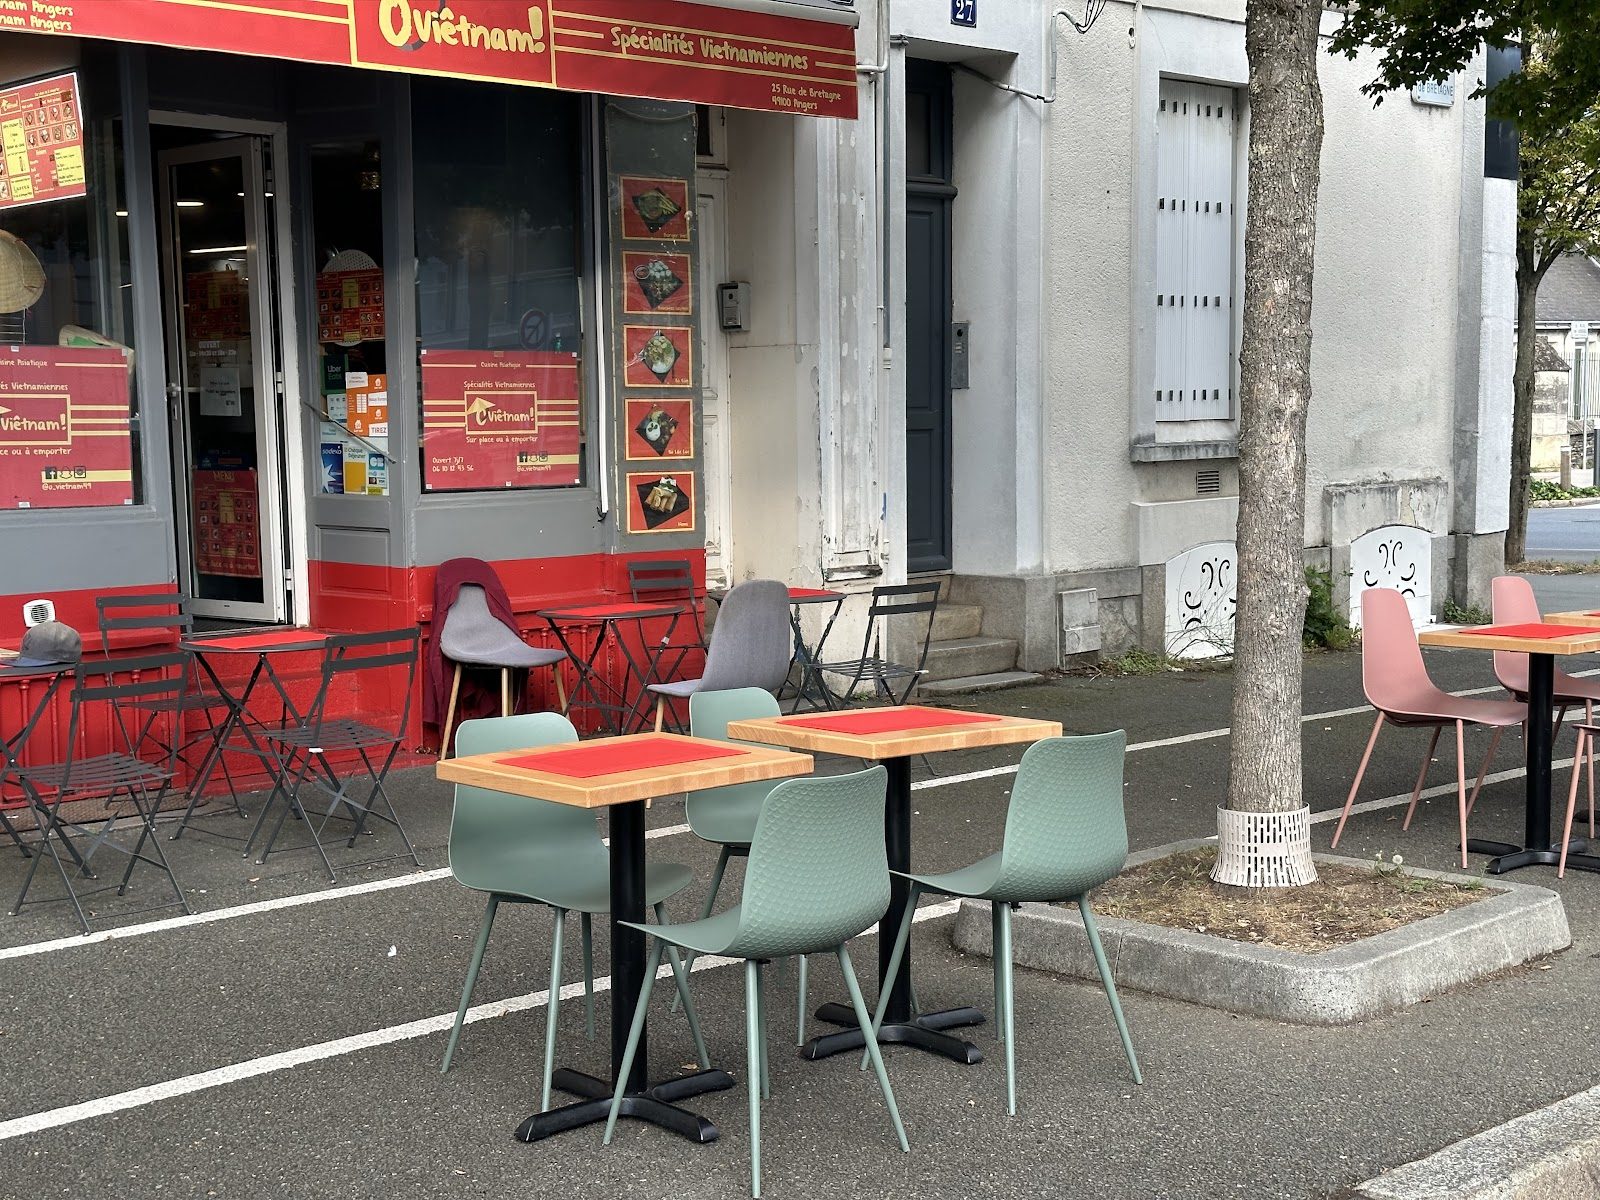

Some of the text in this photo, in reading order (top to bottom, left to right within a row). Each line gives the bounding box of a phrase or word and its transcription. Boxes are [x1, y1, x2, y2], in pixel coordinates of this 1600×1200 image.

[32, 0, 73, 19] Angers
[955, 0, 973, 21] 27
[30, 15, 72, 32] Angers
[610, 27, 808, 70] Spécialités Vietnamiennes
[772, 83, 841, 104] 25 Rue de Bretagne
[793, 97, 818, 111] Angers
[17, 359, 48, 368] Asiatique
[327, 365, 341, 373] Uber
[11, 382, 69, 391] Vietnamiennes
[464, 381, 493, 389] Spécialités
[0, 413, 67, 431] Viêtnam!
[371, 426, 387, 434] TIREZ
[479, 436, 494, 445] place
[511, 436, 538, 445] emporter
[12, 448, 22, 456] ou
[25, 446, 30, 455] à
[33, 447, 72, 457] emporter
[432, 456, 452, 464] Ouvert
[432, 465, 441, 473] 06
